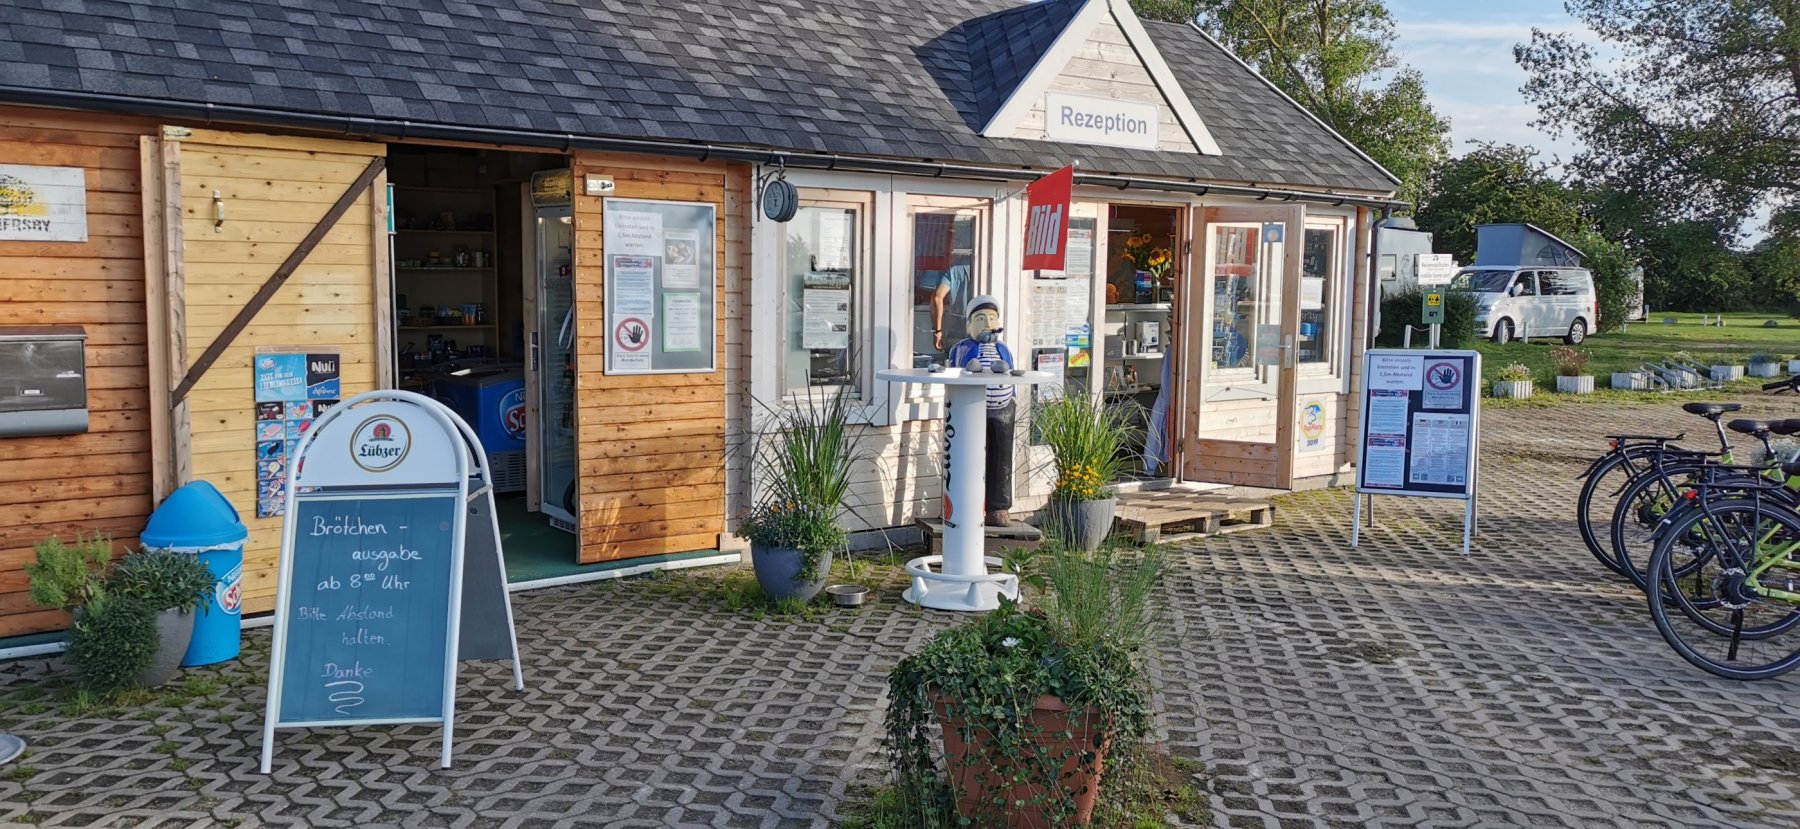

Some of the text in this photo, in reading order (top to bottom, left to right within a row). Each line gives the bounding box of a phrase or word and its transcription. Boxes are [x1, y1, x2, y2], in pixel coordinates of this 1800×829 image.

[1061, 105, 1147, 135] Rezeption
[1026, 203, 1063, 256] Bild
[358, 443, 401, 459] Lübzer
[310, 515, 387, 537] Brötchen
[352, 544, 423, 571] ausgabe
[317, 576, 341, 591] ab
[381, 576, 411, 590] Uhr
[297, 604, 395, 621] Bitte Abstand
